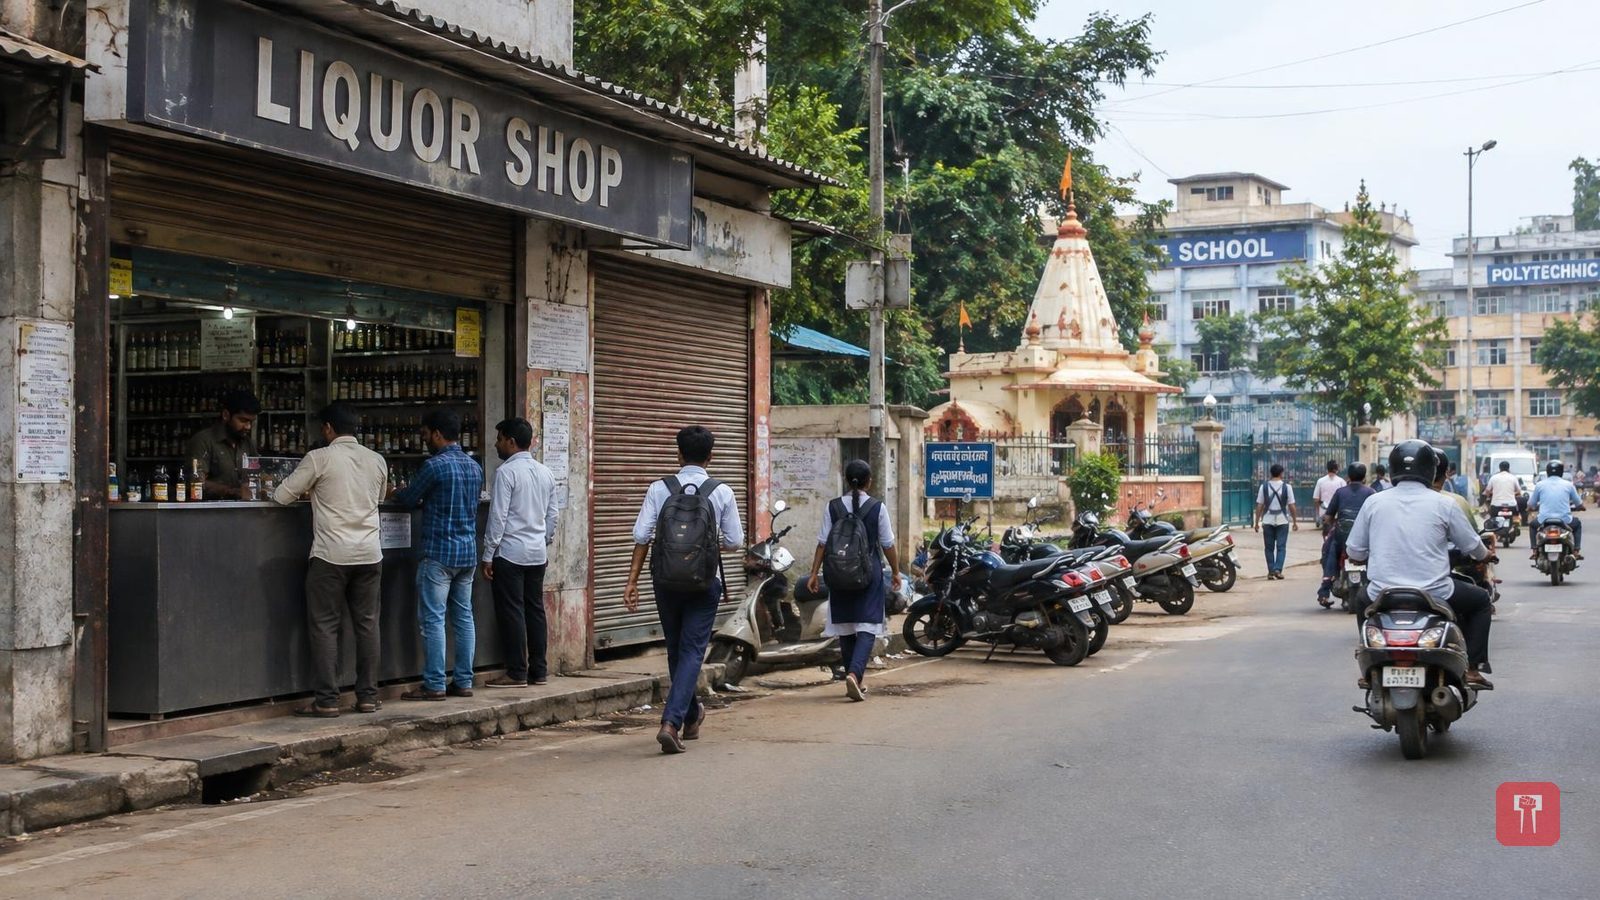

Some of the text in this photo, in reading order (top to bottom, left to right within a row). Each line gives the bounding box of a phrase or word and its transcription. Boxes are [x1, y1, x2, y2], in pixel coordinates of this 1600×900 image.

[256, 36, 624, 208] LIQUOR SHOP
[1178, 238, 1274, 262] SCHOOL
[1491, 262, 1599, 282] POLYTECHNIC
